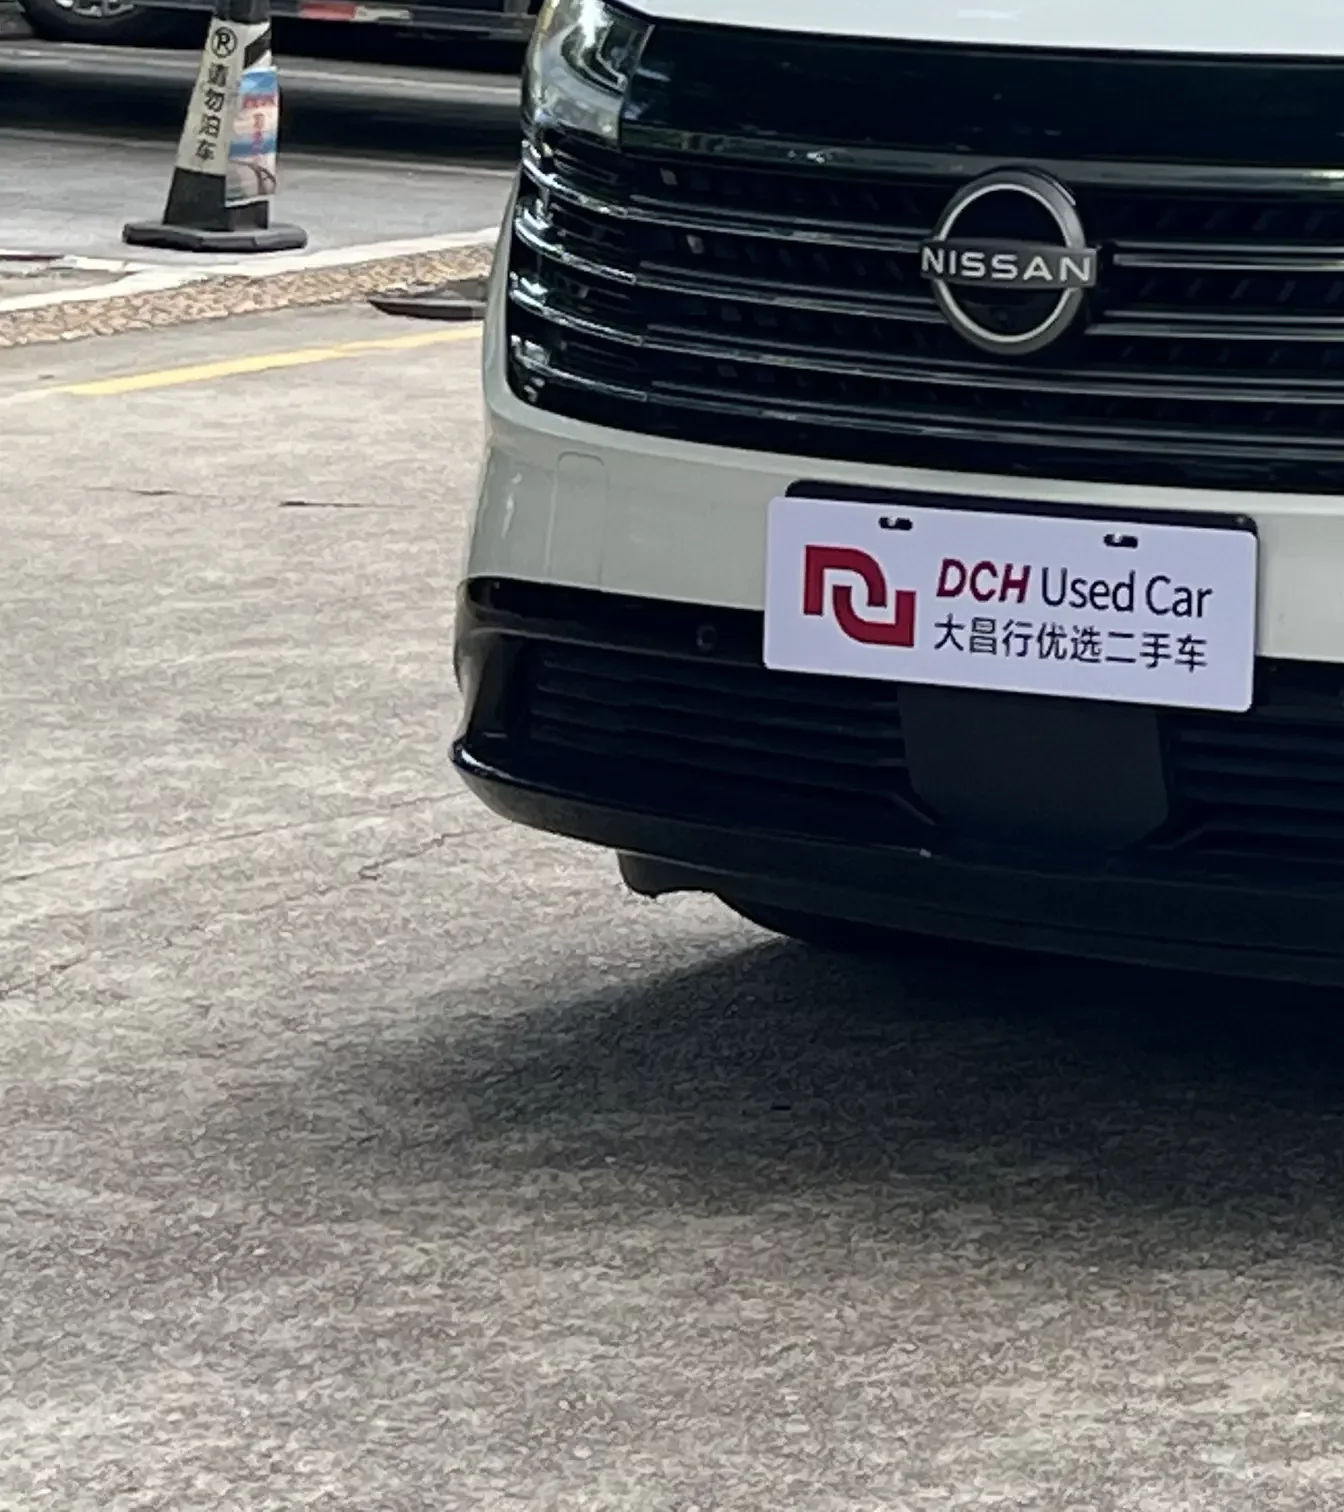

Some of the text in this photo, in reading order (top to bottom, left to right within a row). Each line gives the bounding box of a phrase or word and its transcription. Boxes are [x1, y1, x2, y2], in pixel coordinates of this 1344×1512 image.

[195, 62, 229, 161] 请勿泊车
[921, 246, 1092, 283] NISSAN
[935, 558, 1214, 619] DCH Used Car
[933, 612, 1208, 673] 大昌行优选二手车
